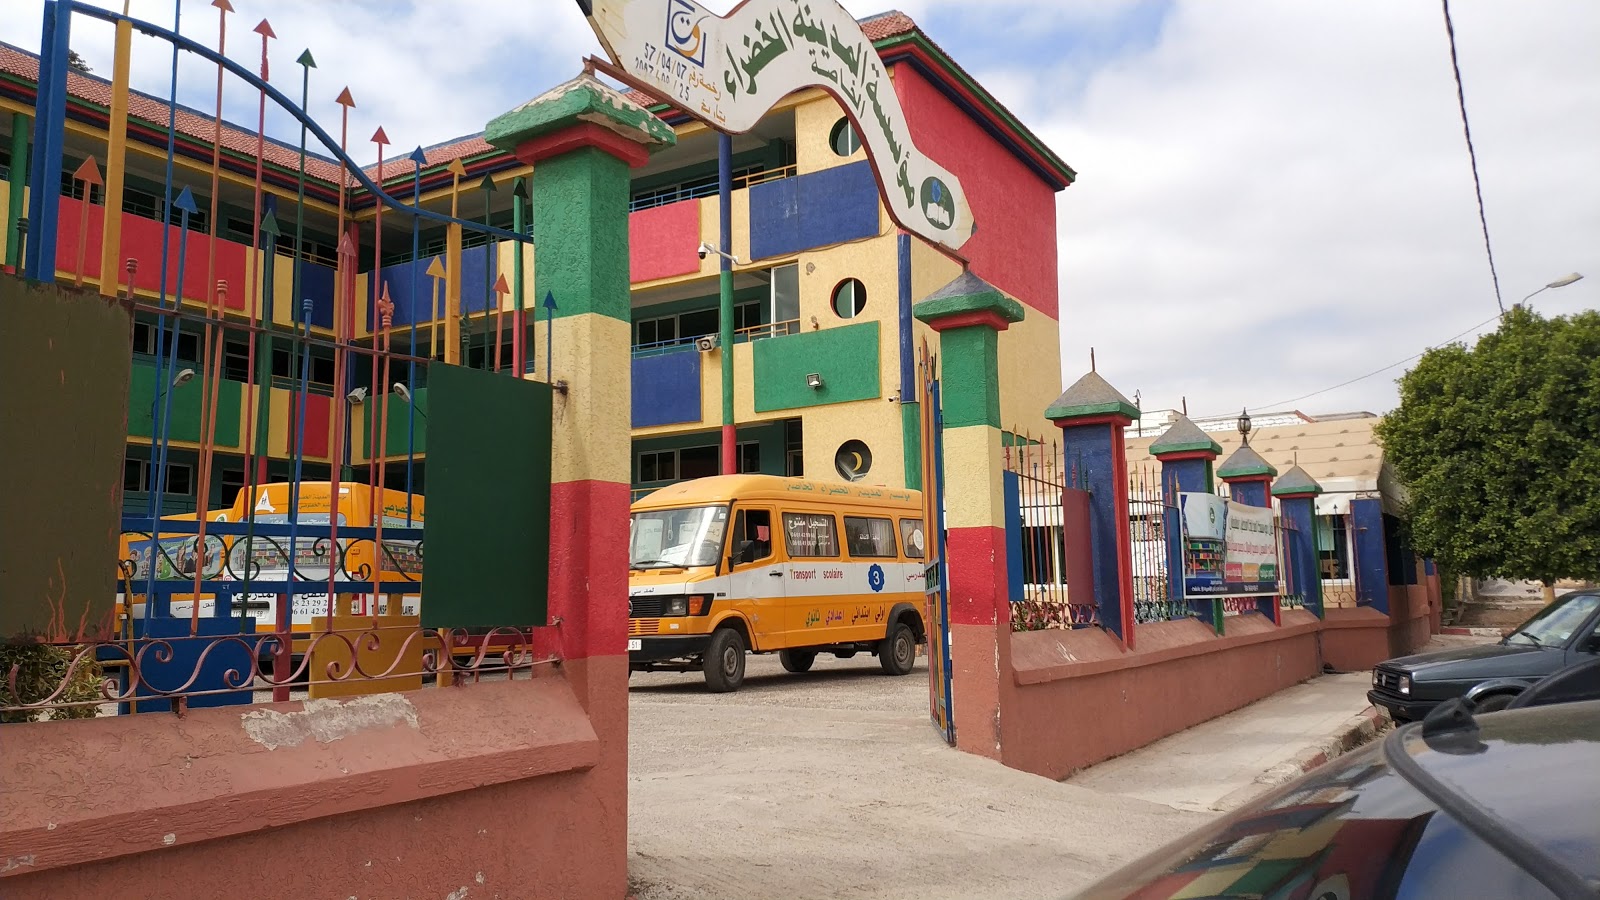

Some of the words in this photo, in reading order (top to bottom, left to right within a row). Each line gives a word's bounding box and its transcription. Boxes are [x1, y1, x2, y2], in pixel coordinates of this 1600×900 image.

[792, 0, 867, 87] المدينة
[724, 7, 794, 103] الخضراء
[788, 517, 806, 529] مفتوح
[808, 518, 829, 529] التسجيل
[789, 568, 816, 582] Transport
[823, 568, 843, 579] scolaire
[873, 570, 880, 585] 3
[631, 641, 638, 649] 51
